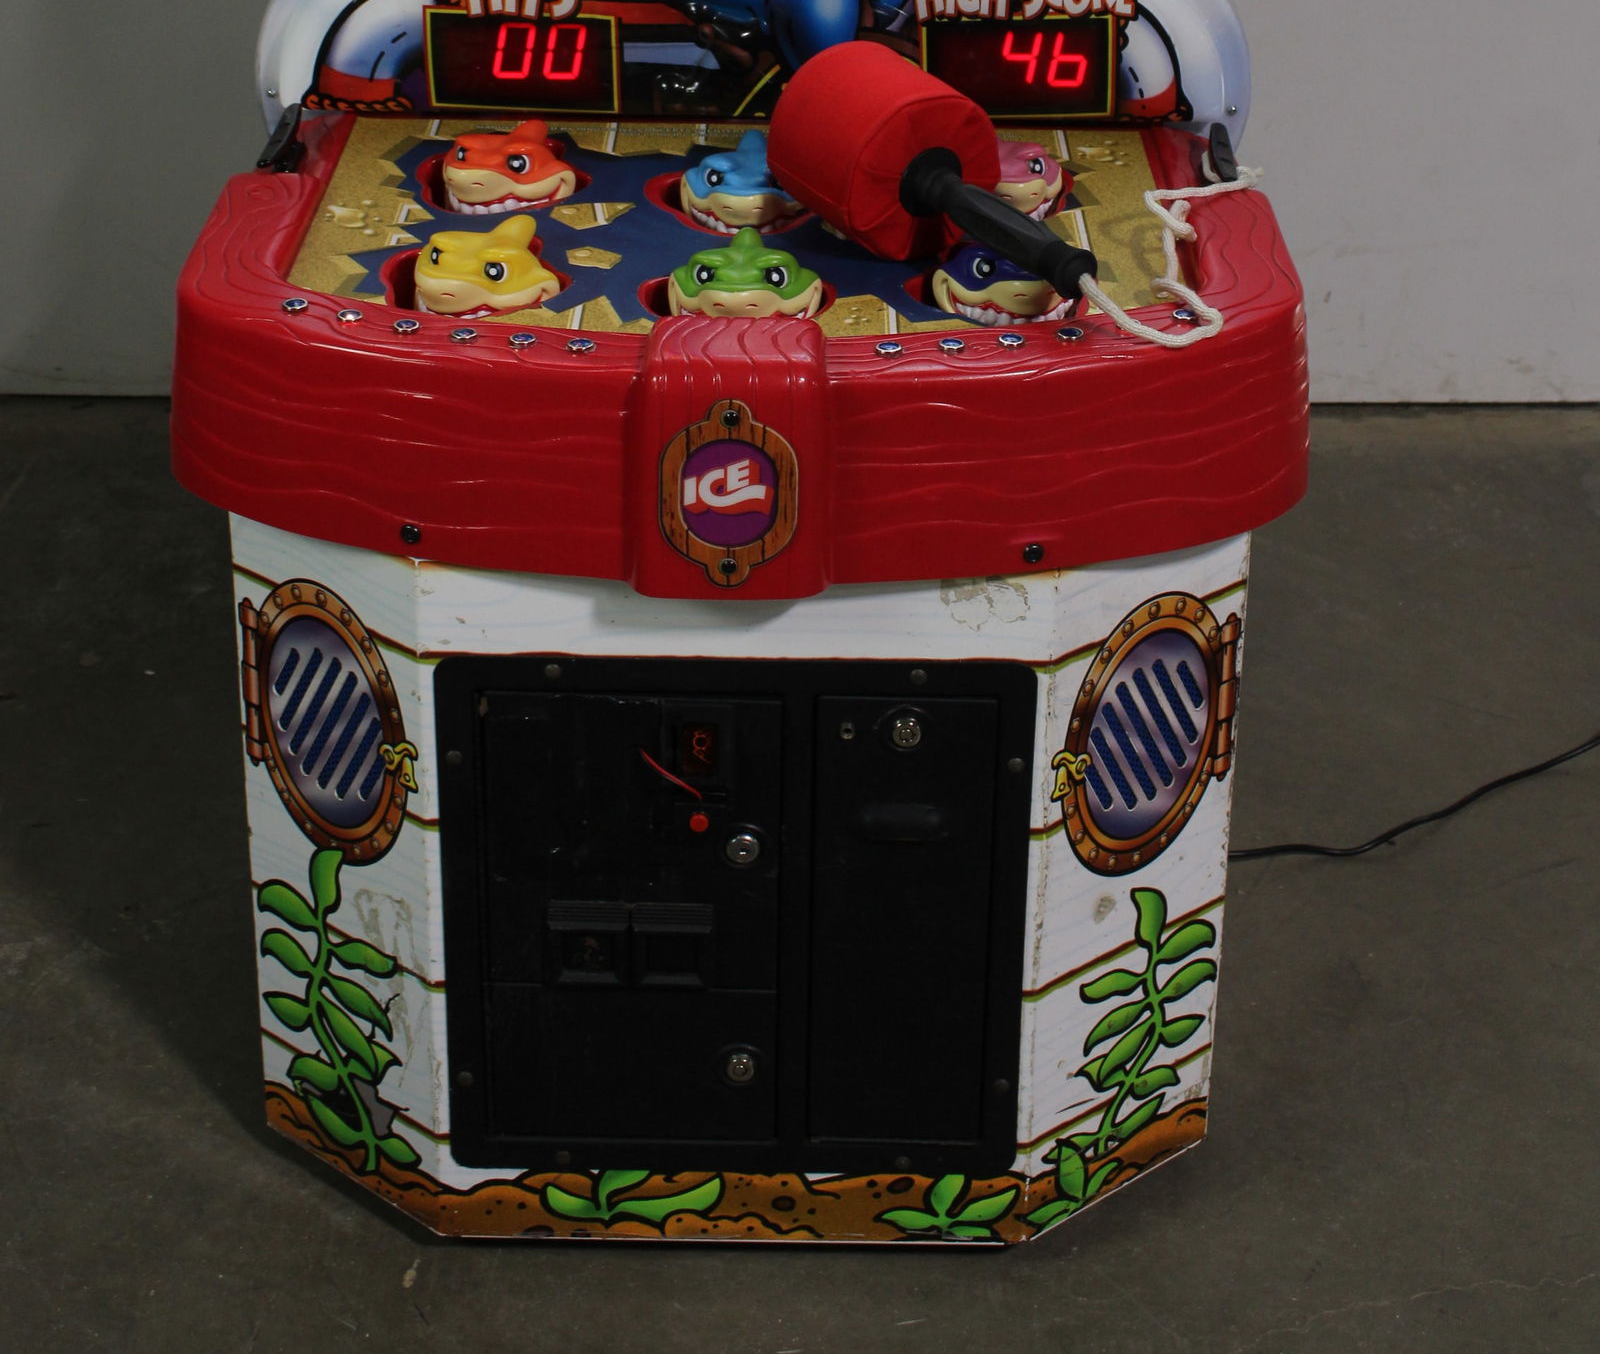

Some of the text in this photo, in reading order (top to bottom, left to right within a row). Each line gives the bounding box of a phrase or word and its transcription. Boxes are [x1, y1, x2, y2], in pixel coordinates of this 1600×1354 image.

[492, 22, 587, 80] 00
[1002, 31, 1088, 88] 46
[683, 459, 767, 508] ICE
